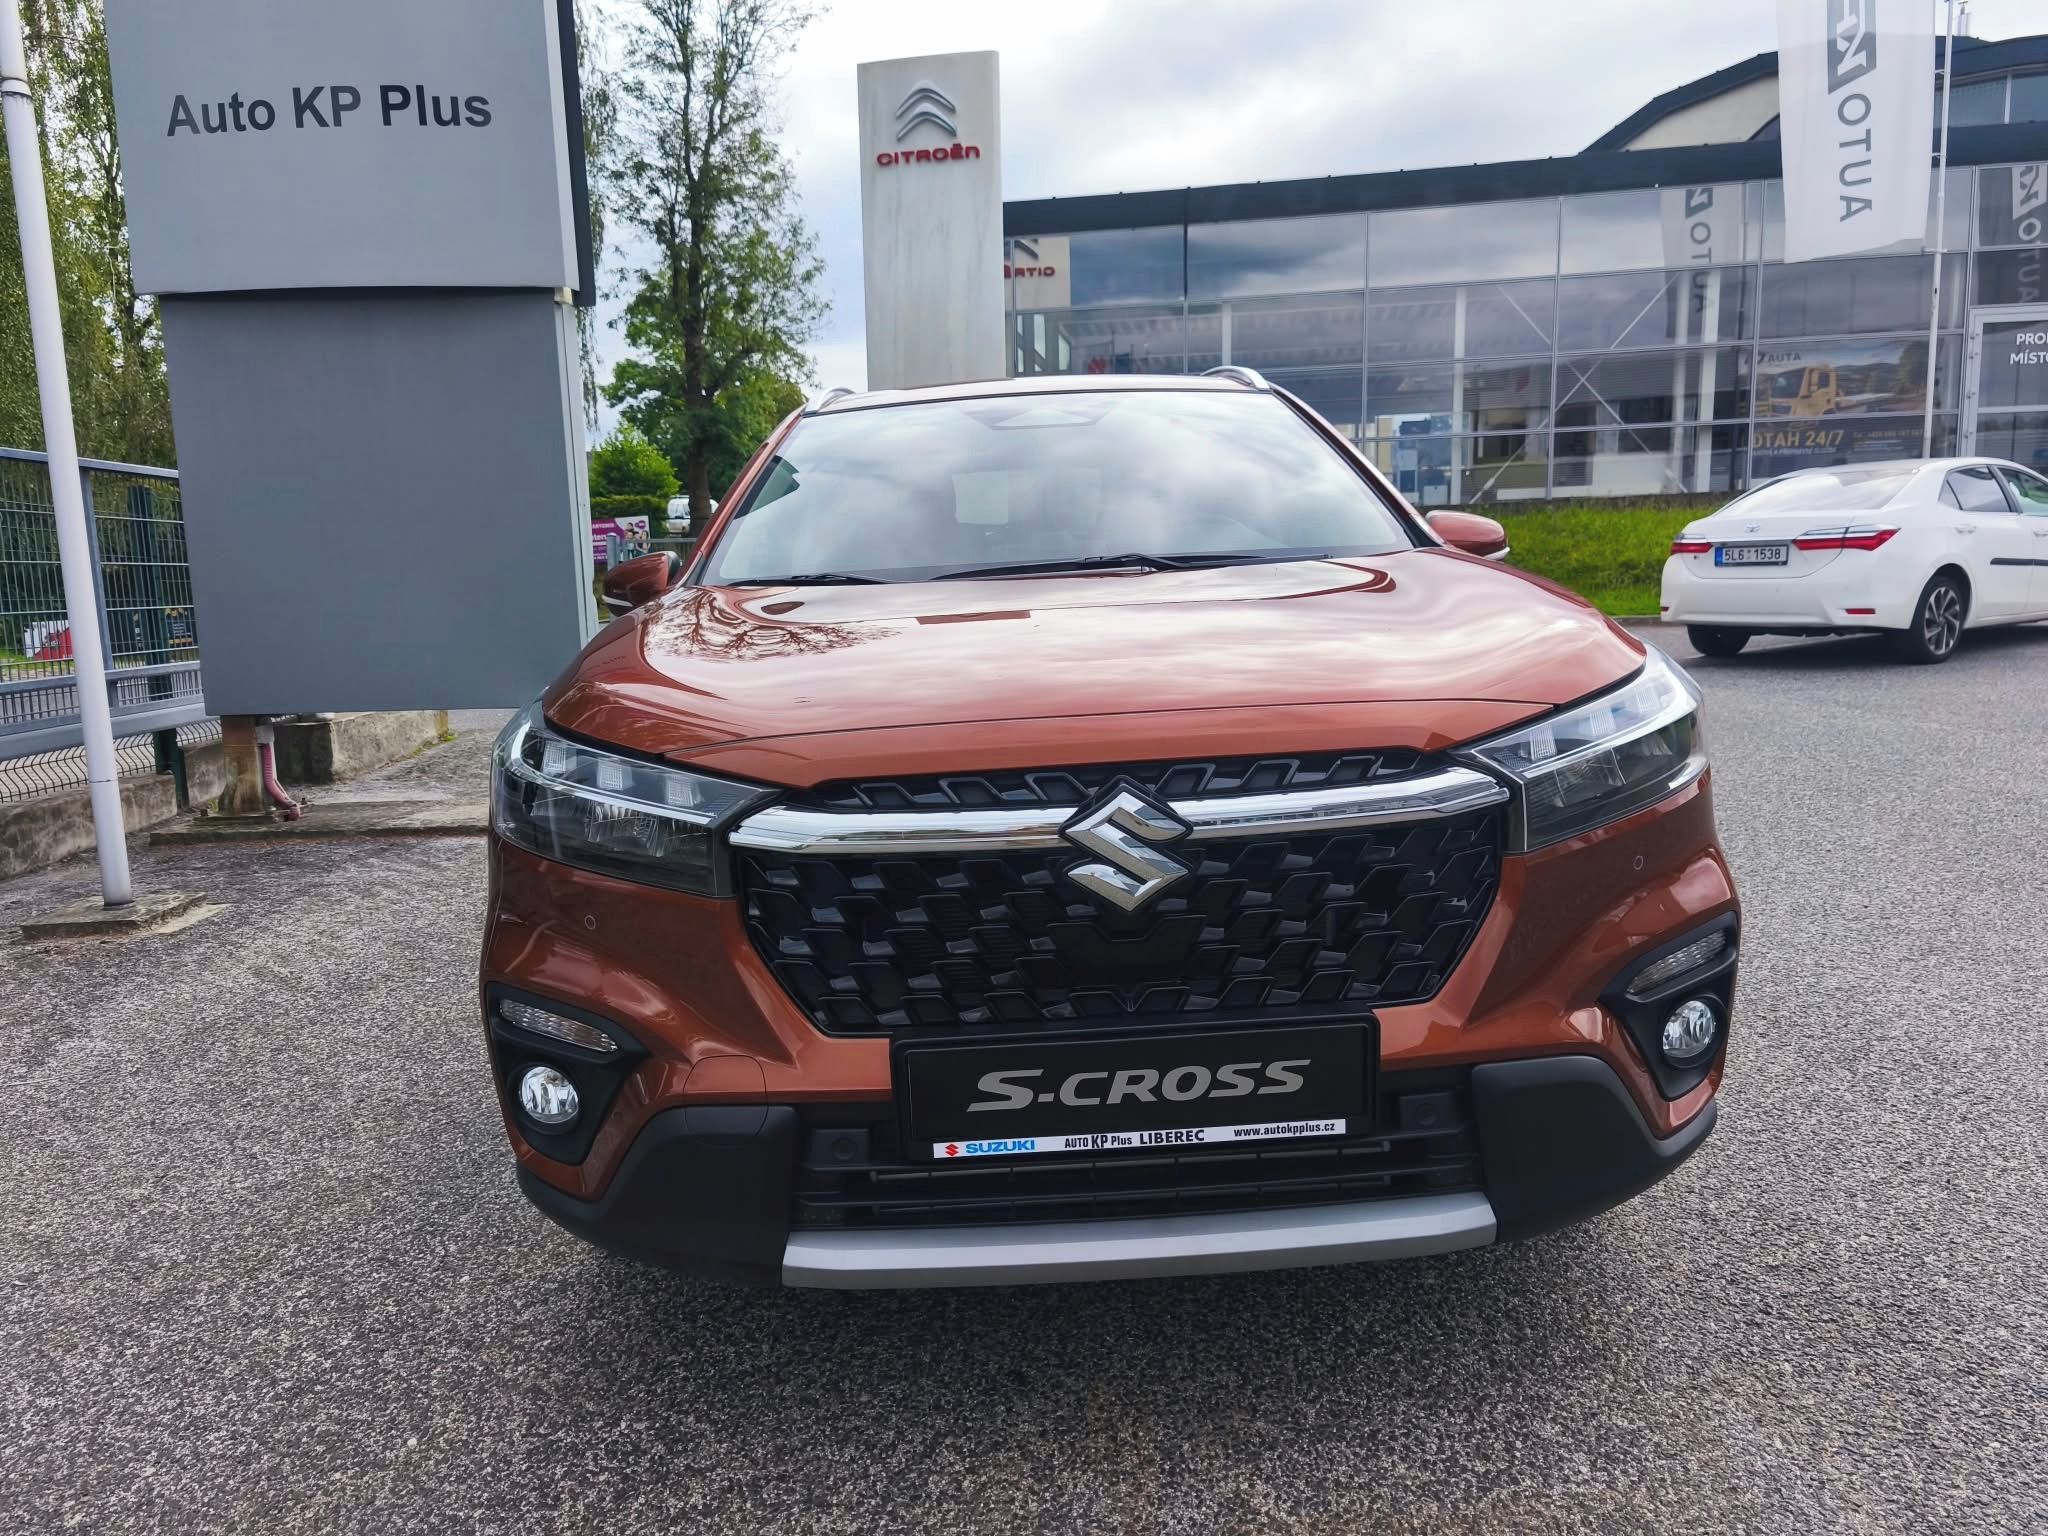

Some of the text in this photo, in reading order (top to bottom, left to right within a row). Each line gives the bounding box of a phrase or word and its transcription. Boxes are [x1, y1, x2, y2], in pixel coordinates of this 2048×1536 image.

[166, 84, 493, 137] Auto KP Plus
[2016, 332, 2048, 345] PRO
[1725, 548, 1781, 561] 5L6 1538
[966, 1059, 1311, 1112] S-CROSS
[965, 1122, 1336, 1154] SUZUKI AUTO KP Plus LIBEREC www.autokpplus.cz
